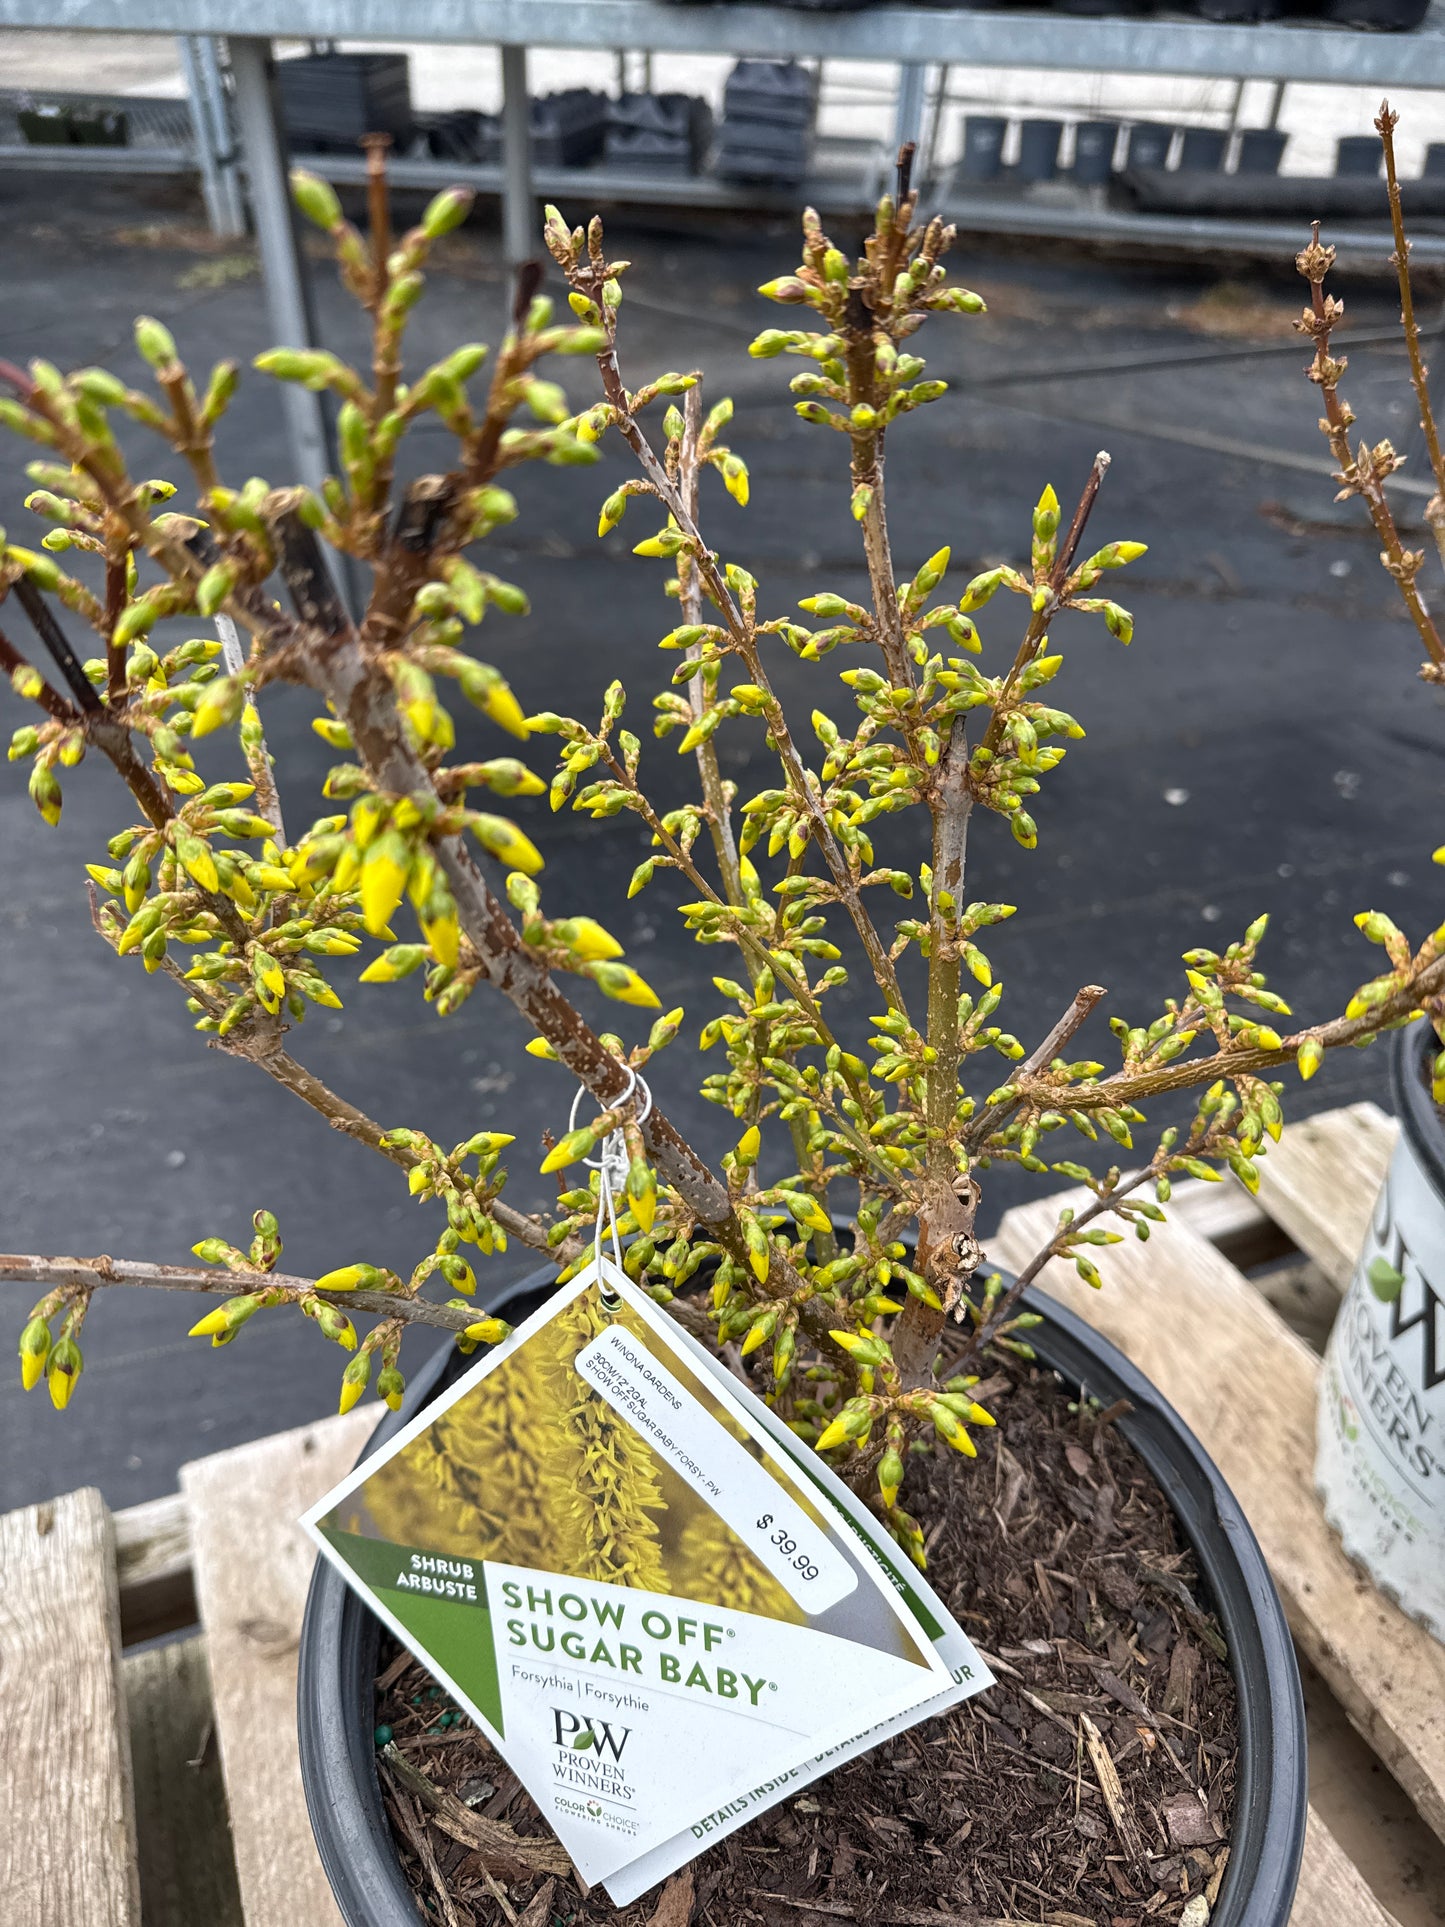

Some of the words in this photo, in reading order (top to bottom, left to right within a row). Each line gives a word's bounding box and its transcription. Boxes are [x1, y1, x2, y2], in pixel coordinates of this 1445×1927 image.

[611, 1337, 644, 1372] WINONA
[643, 1370, 682, 1410] GARDENS
[1353, 1270, 1434, 1435] OVEN
[586, 1360, 613, 1386] SHOW
[611, 1385, 630, 1401] OFF
[627, 1401, 656, 1431] SUGAR
[654, 1429, 678, 1450] BABY
[626, 1386, 648, 1410] 2GAL
[410, 1554, 475, 1580] SHRUB
[771, 1530, 819, 1580] 39.99
[396, 1571, 478, 1601] ARBUSTE
[502, 1581, 625, 1631] SHOW
[507, 1618, 643, 1675] SUGAR
[512, 1664, 573, 1691] Forsythia
[585, 1682, 649, 1711] Forsythie
[558, 1750, 625, 1781] PROVEN
[554, 1796, 586, 1813] COLOR
[555, 1806, 601, 1825] FLOWERING
[606, 1822, 637, 1837] SHRUBS
[690, 1798, 749, 1839] DETAILS
